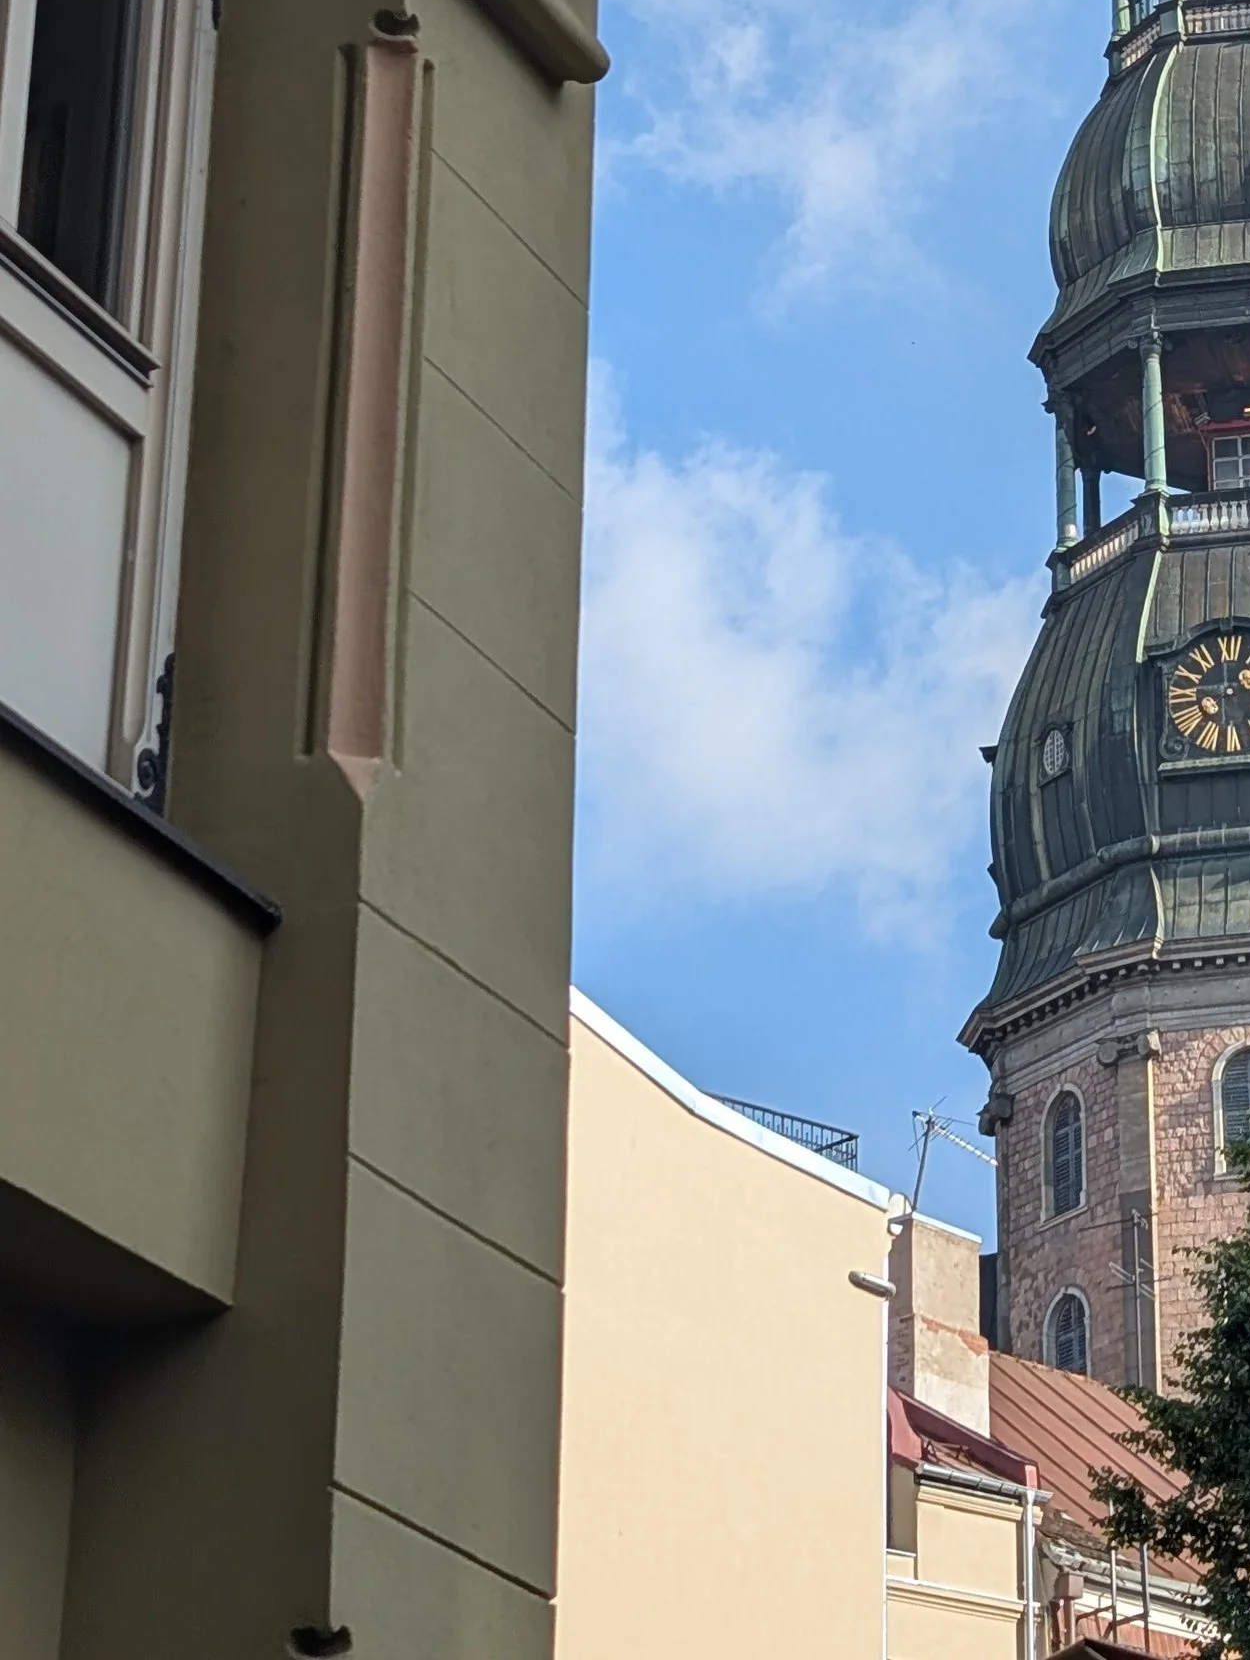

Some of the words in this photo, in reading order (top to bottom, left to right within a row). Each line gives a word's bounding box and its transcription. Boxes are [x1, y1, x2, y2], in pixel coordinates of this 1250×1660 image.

[1189, 644, 1215, 673] XI
[1217, 635, 1242, 663] XII
[1174, 665, 1203, 684] X
[1169, 686, 1197, 704] IX
[1172, 705, 1203, 737] VIII
[1195, 721, 1220, 752] VII
[1226, 725, 1242, 752] VI
